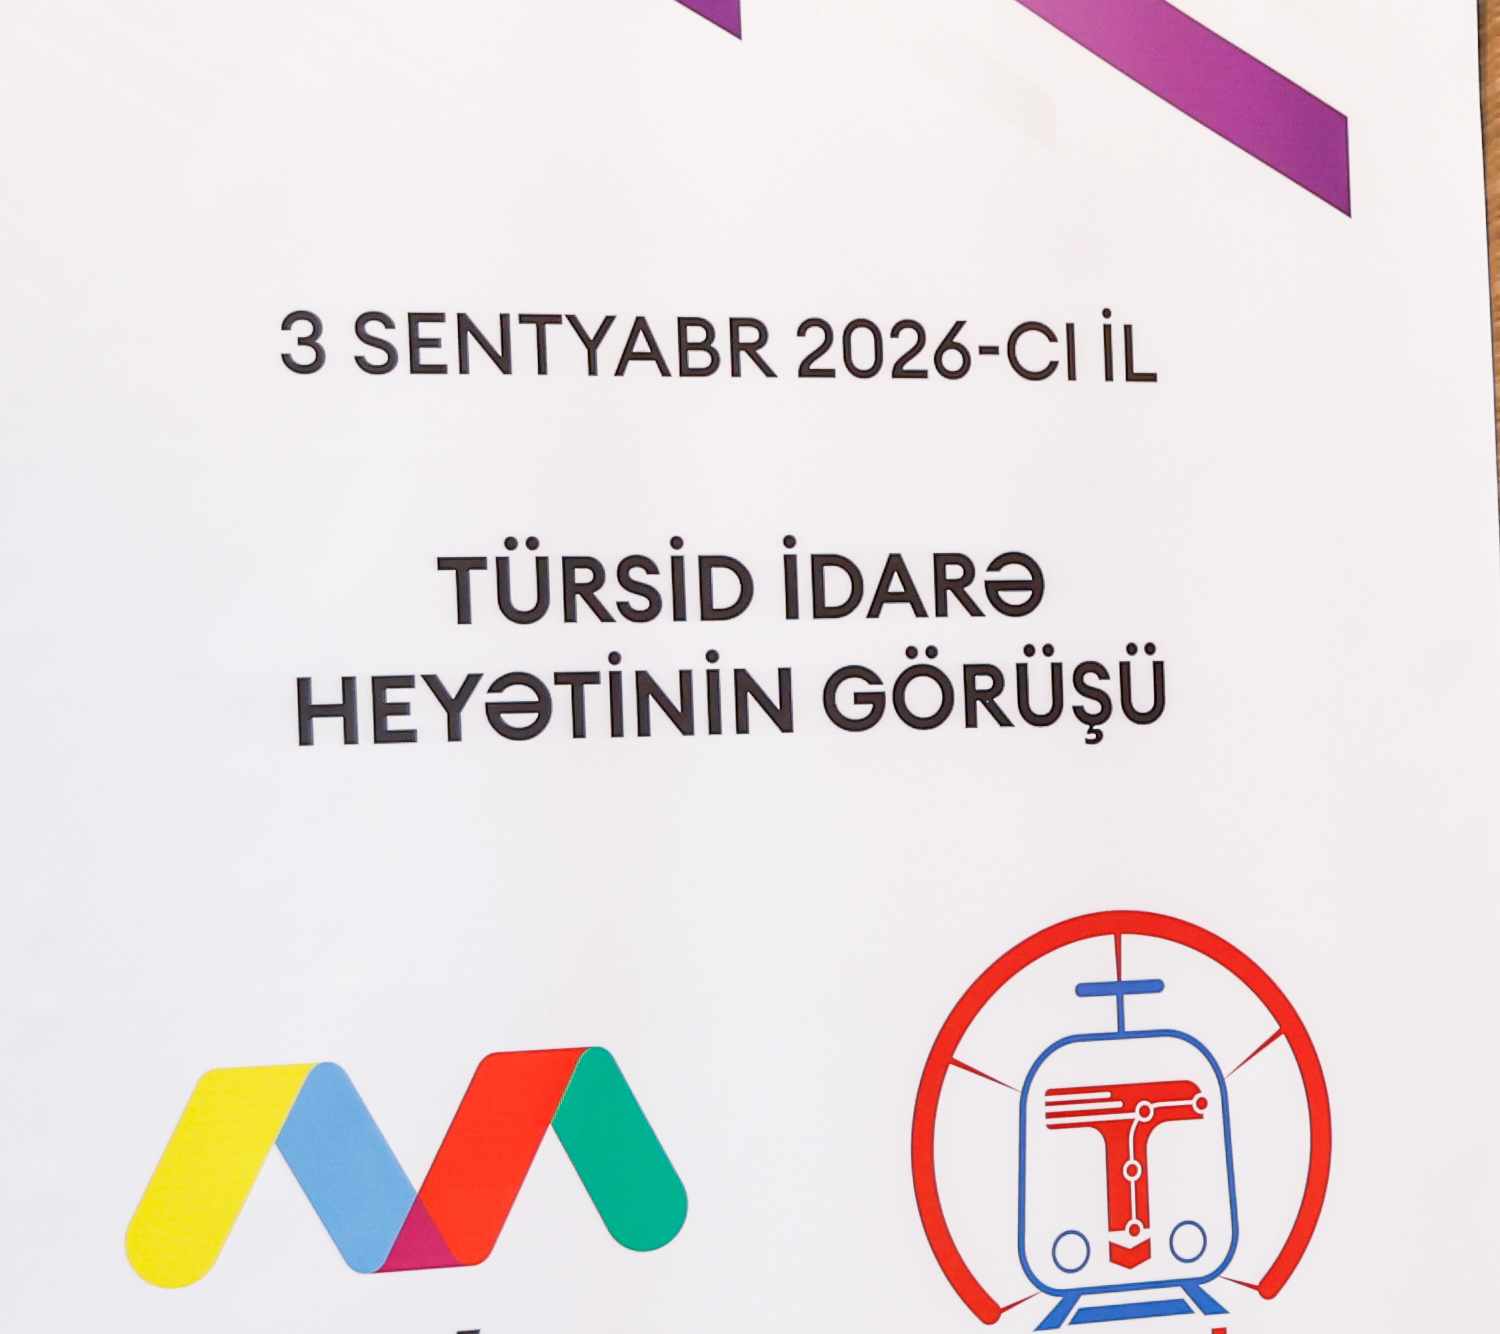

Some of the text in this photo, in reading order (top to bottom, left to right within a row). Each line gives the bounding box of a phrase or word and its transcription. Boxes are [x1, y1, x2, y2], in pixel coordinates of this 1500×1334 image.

[280, 307, 1158, 383] 3 SENTYABR 2026-CI İL
[436, 534, 1046, 625] TÜRSİD İDARƏ
[296, 641, 1166, 747] HEYƏTİNİN GÖRÜŞÜ
